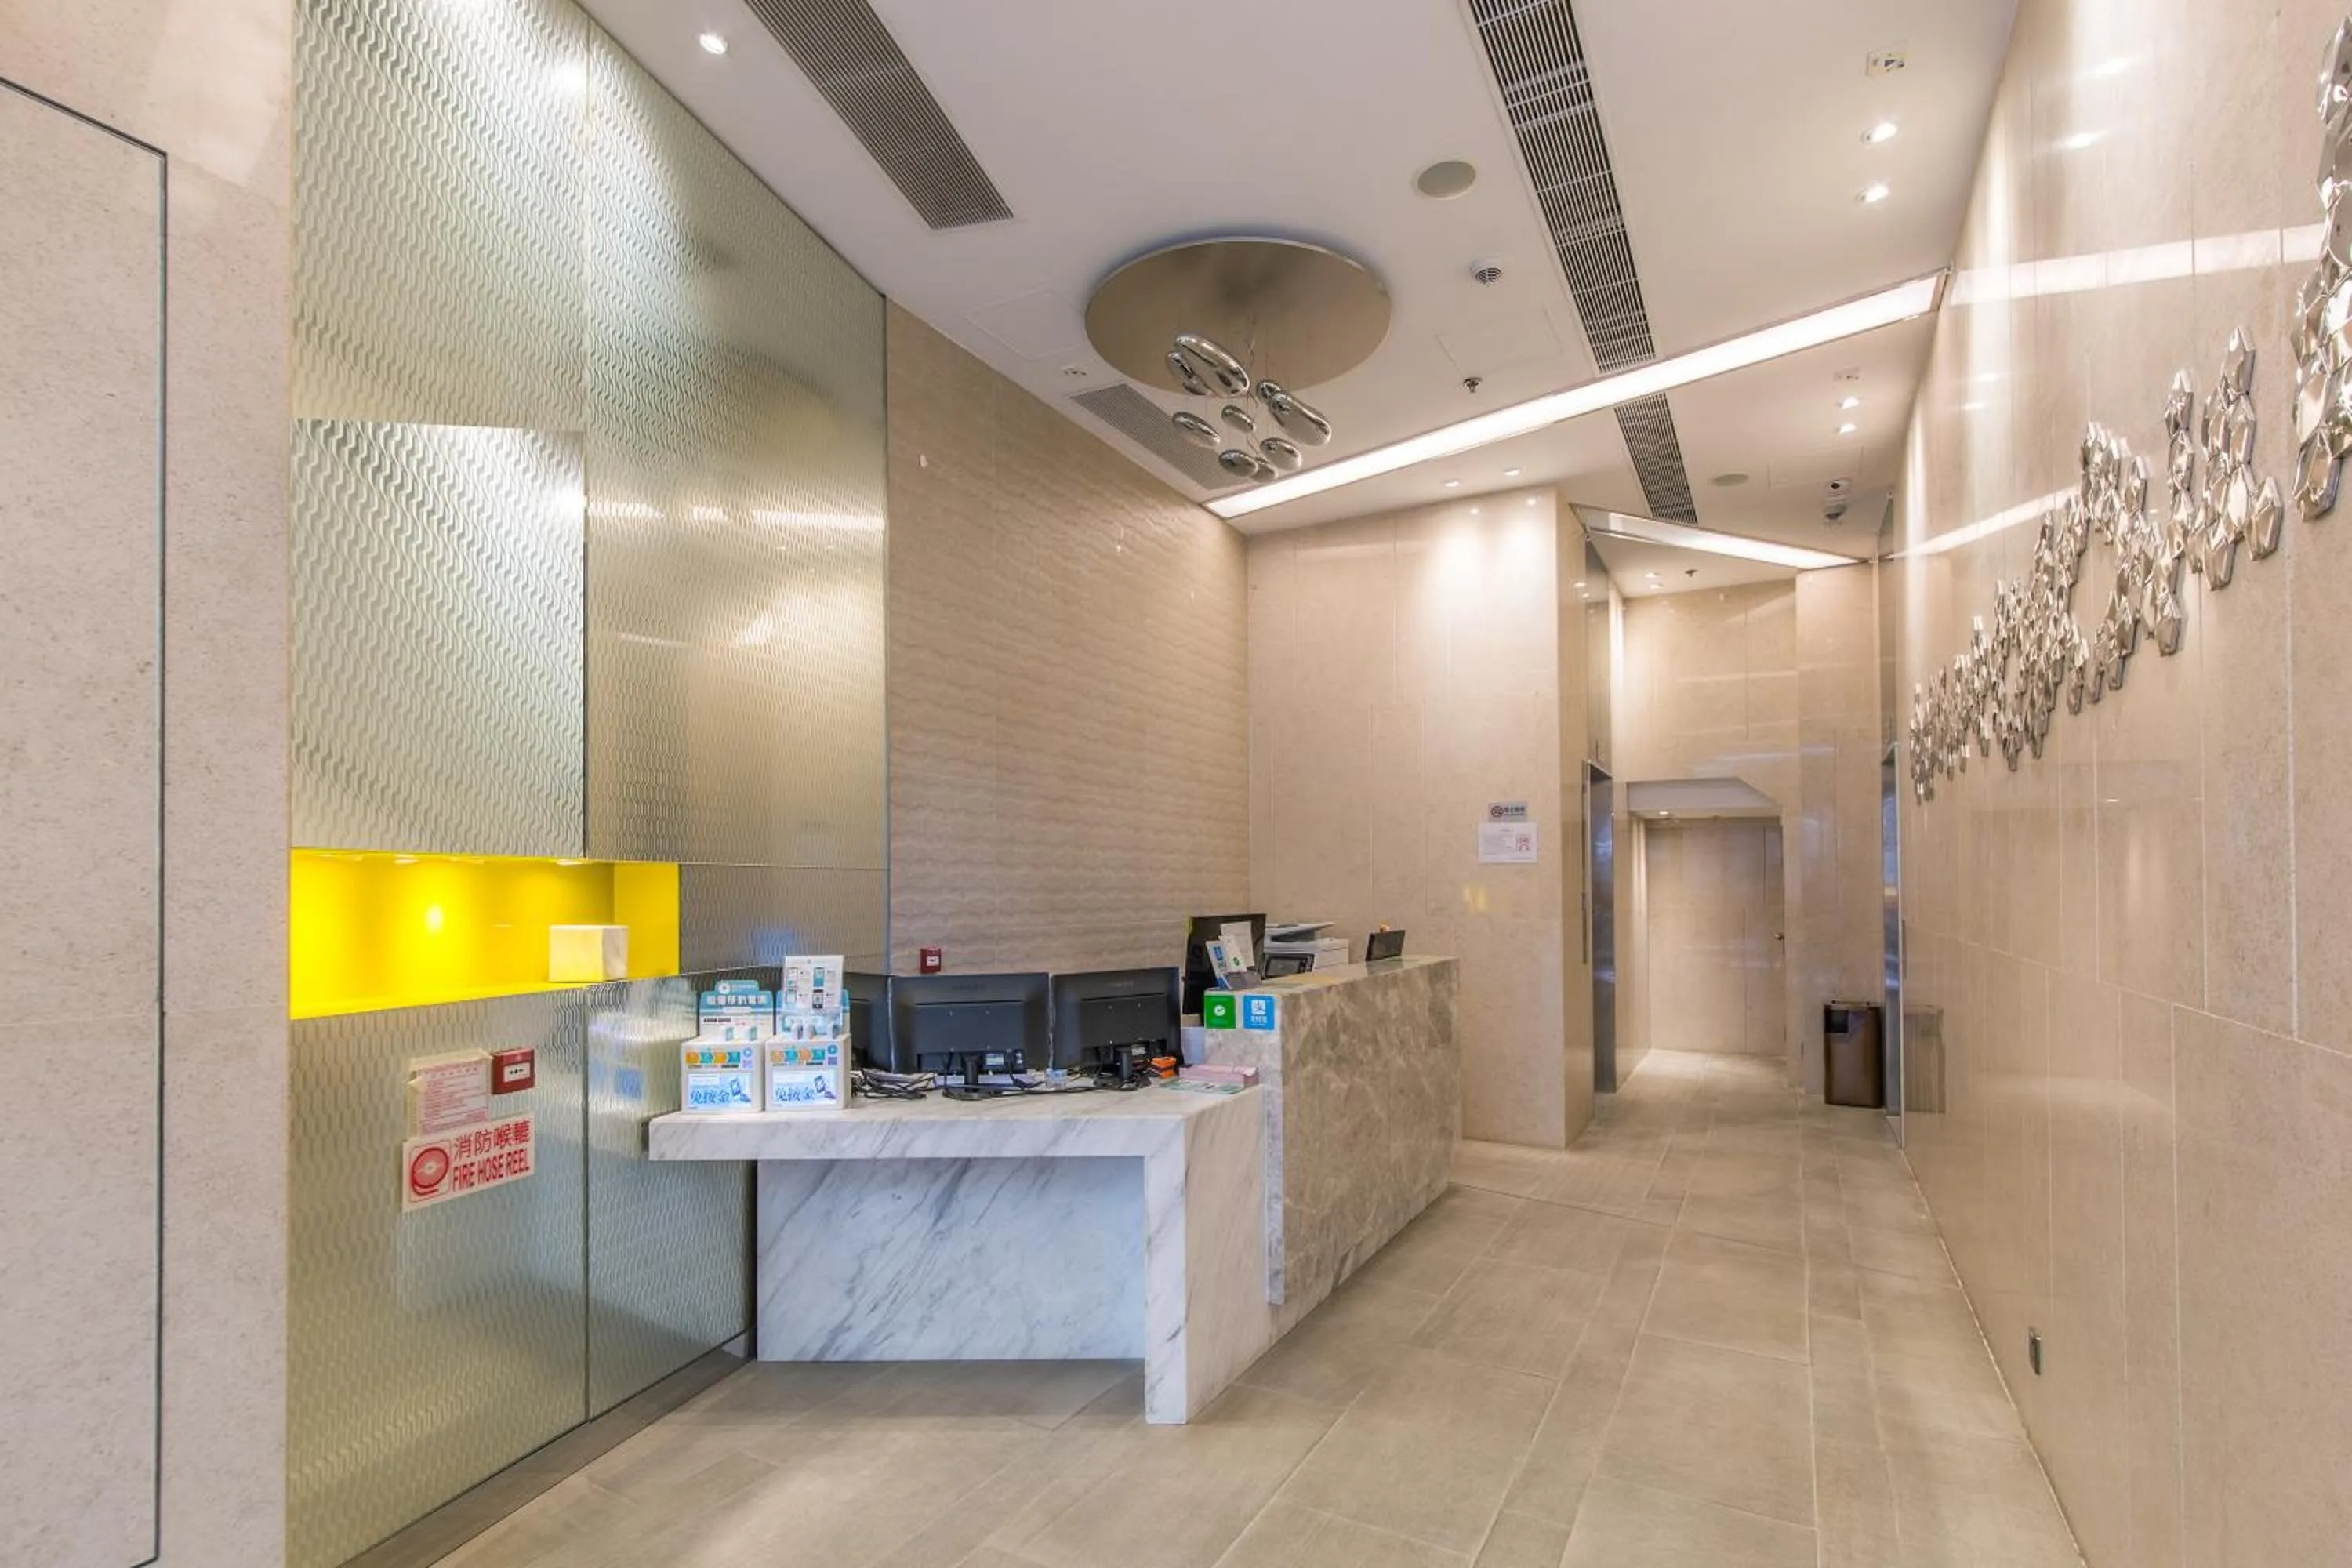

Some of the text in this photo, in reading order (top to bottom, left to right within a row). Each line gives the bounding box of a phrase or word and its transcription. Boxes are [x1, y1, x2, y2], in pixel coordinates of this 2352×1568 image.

[453, 1147, 530, 1192] FIRE HOSE REEL
